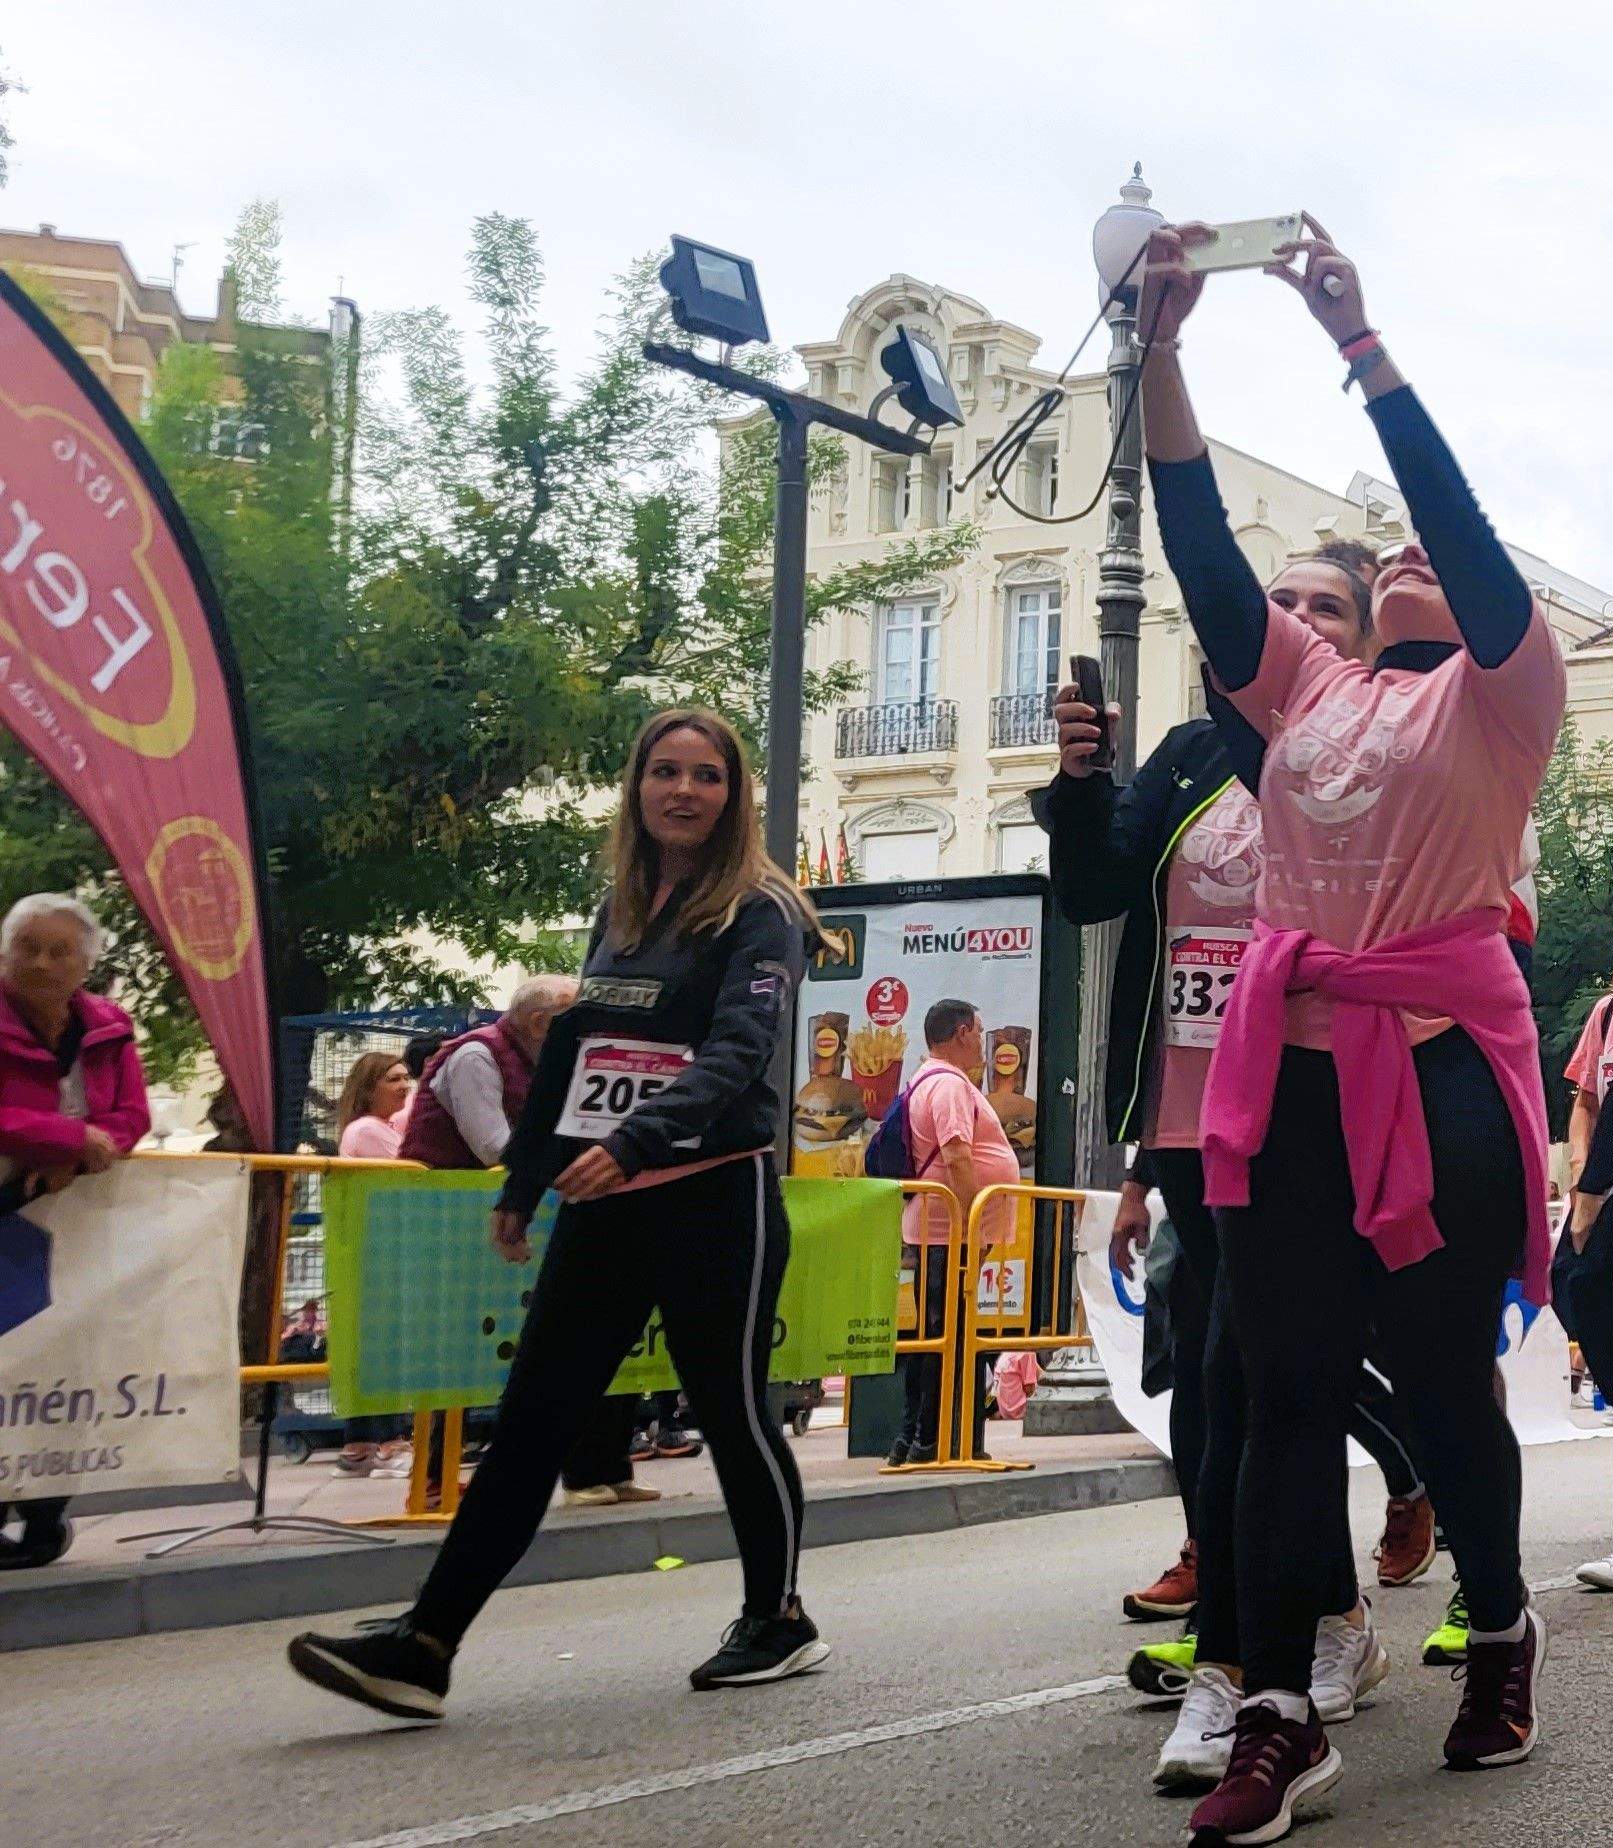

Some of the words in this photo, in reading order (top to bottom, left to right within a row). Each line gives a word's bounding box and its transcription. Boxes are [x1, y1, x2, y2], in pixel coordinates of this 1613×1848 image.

[898, 884, 943, 896] URBAN
[904, 924, 934, 933] Nuevo
[113, 1372, 187, 1420] S.L.
[17, 1445, 125, 1478] PÚBLICAS
